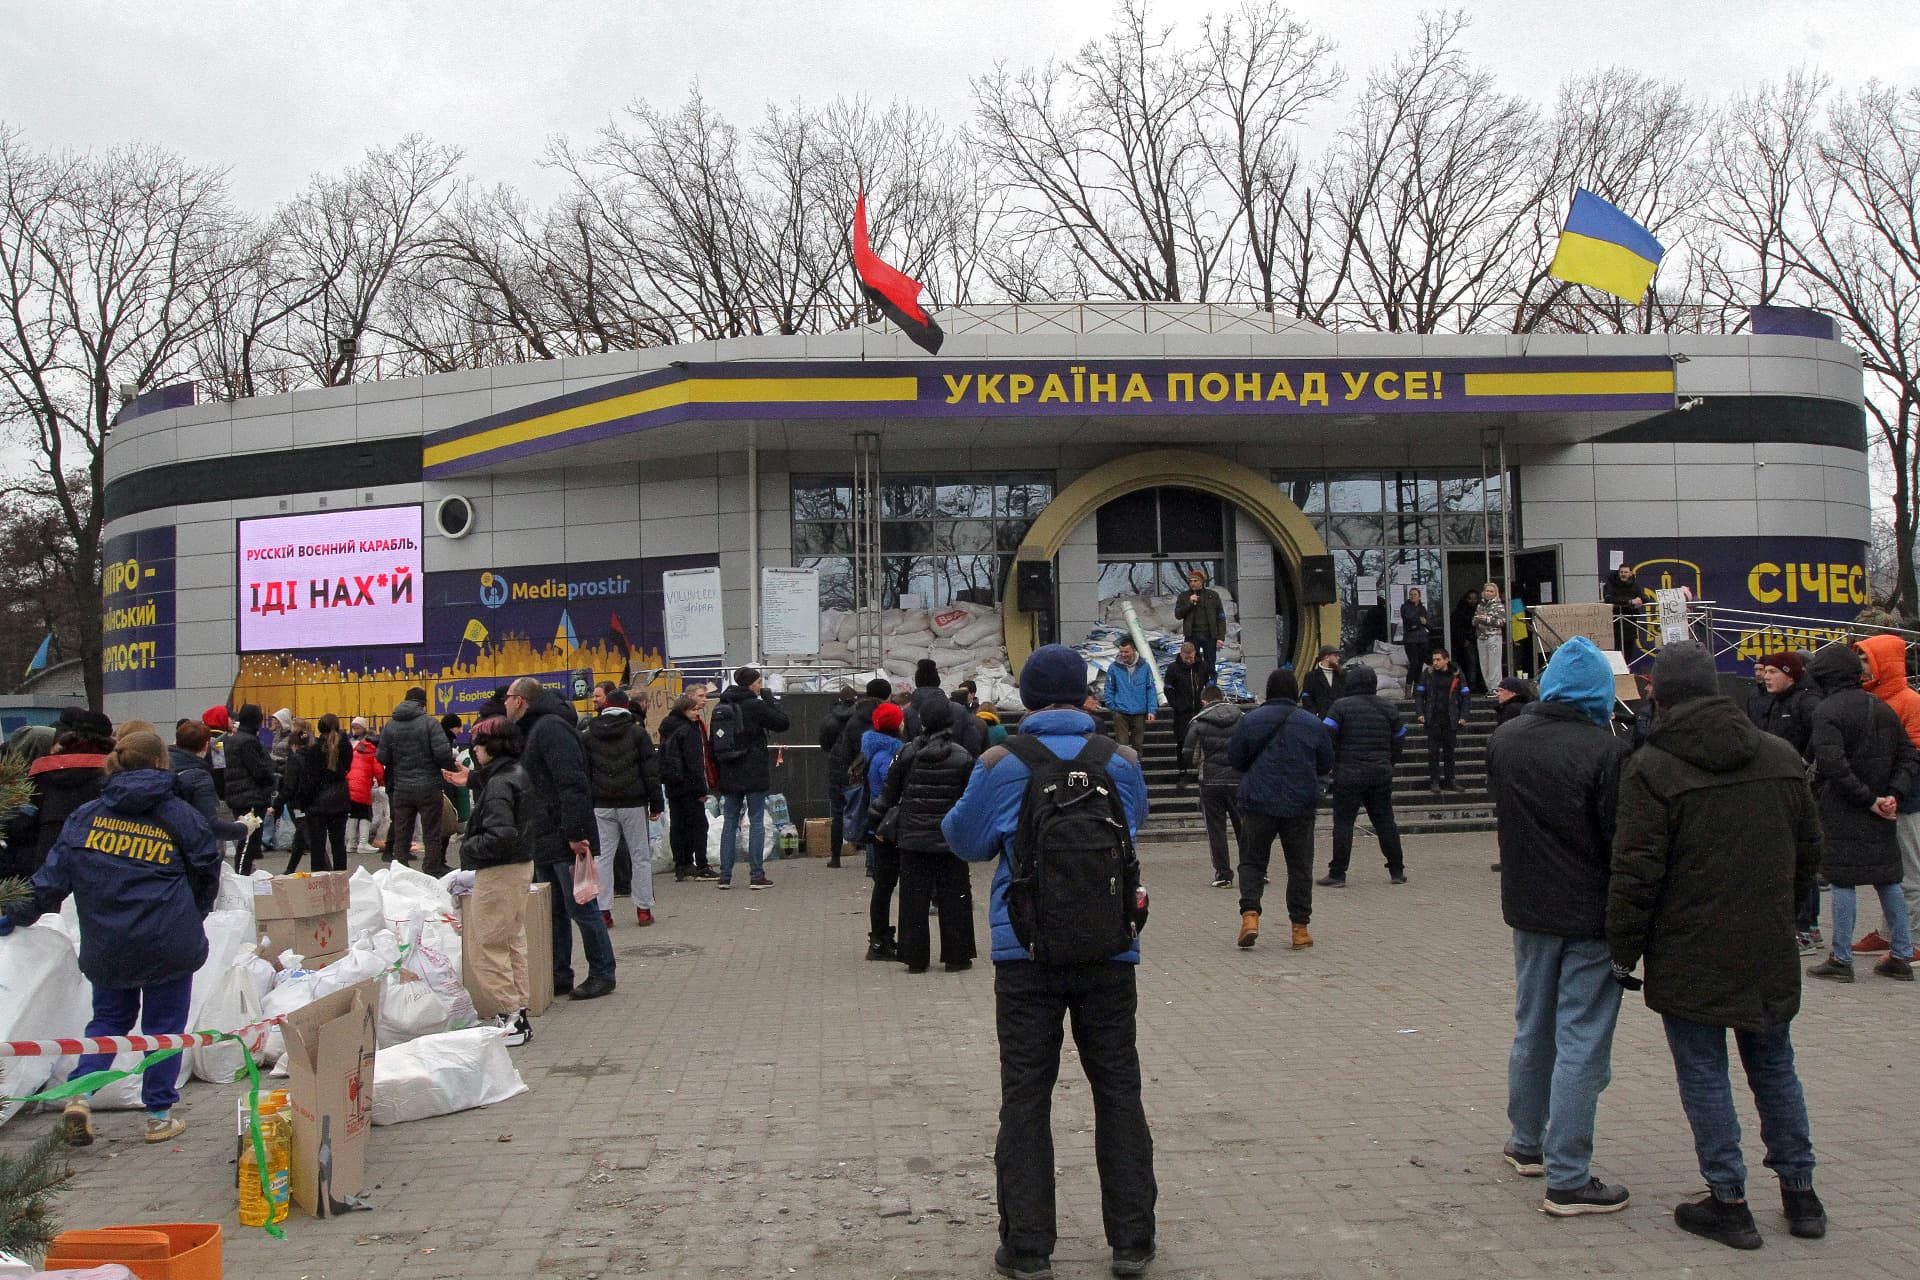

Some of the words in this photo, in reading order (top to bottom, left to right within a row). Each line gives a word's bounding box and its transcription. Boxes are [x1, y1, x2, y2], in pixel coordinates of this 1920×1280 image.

[943, 366, 1152, 404] УКРАЇНА
[1167, 373, 1329, 406] ПОНАД
[1341, 371, 1443, 401] УСЕ!
[247, 544, 295, 561] РУССКІЙ
[298, 539, 356, 557] ВОЄННИЙ
[359, 537, 418, 553] КАРАБЛЬ,
[250, 580, 297, 616] ІДІ
[512, 575, 631, 600] Mediaprostir
[84, 829, 174, 865] КОРПУС
